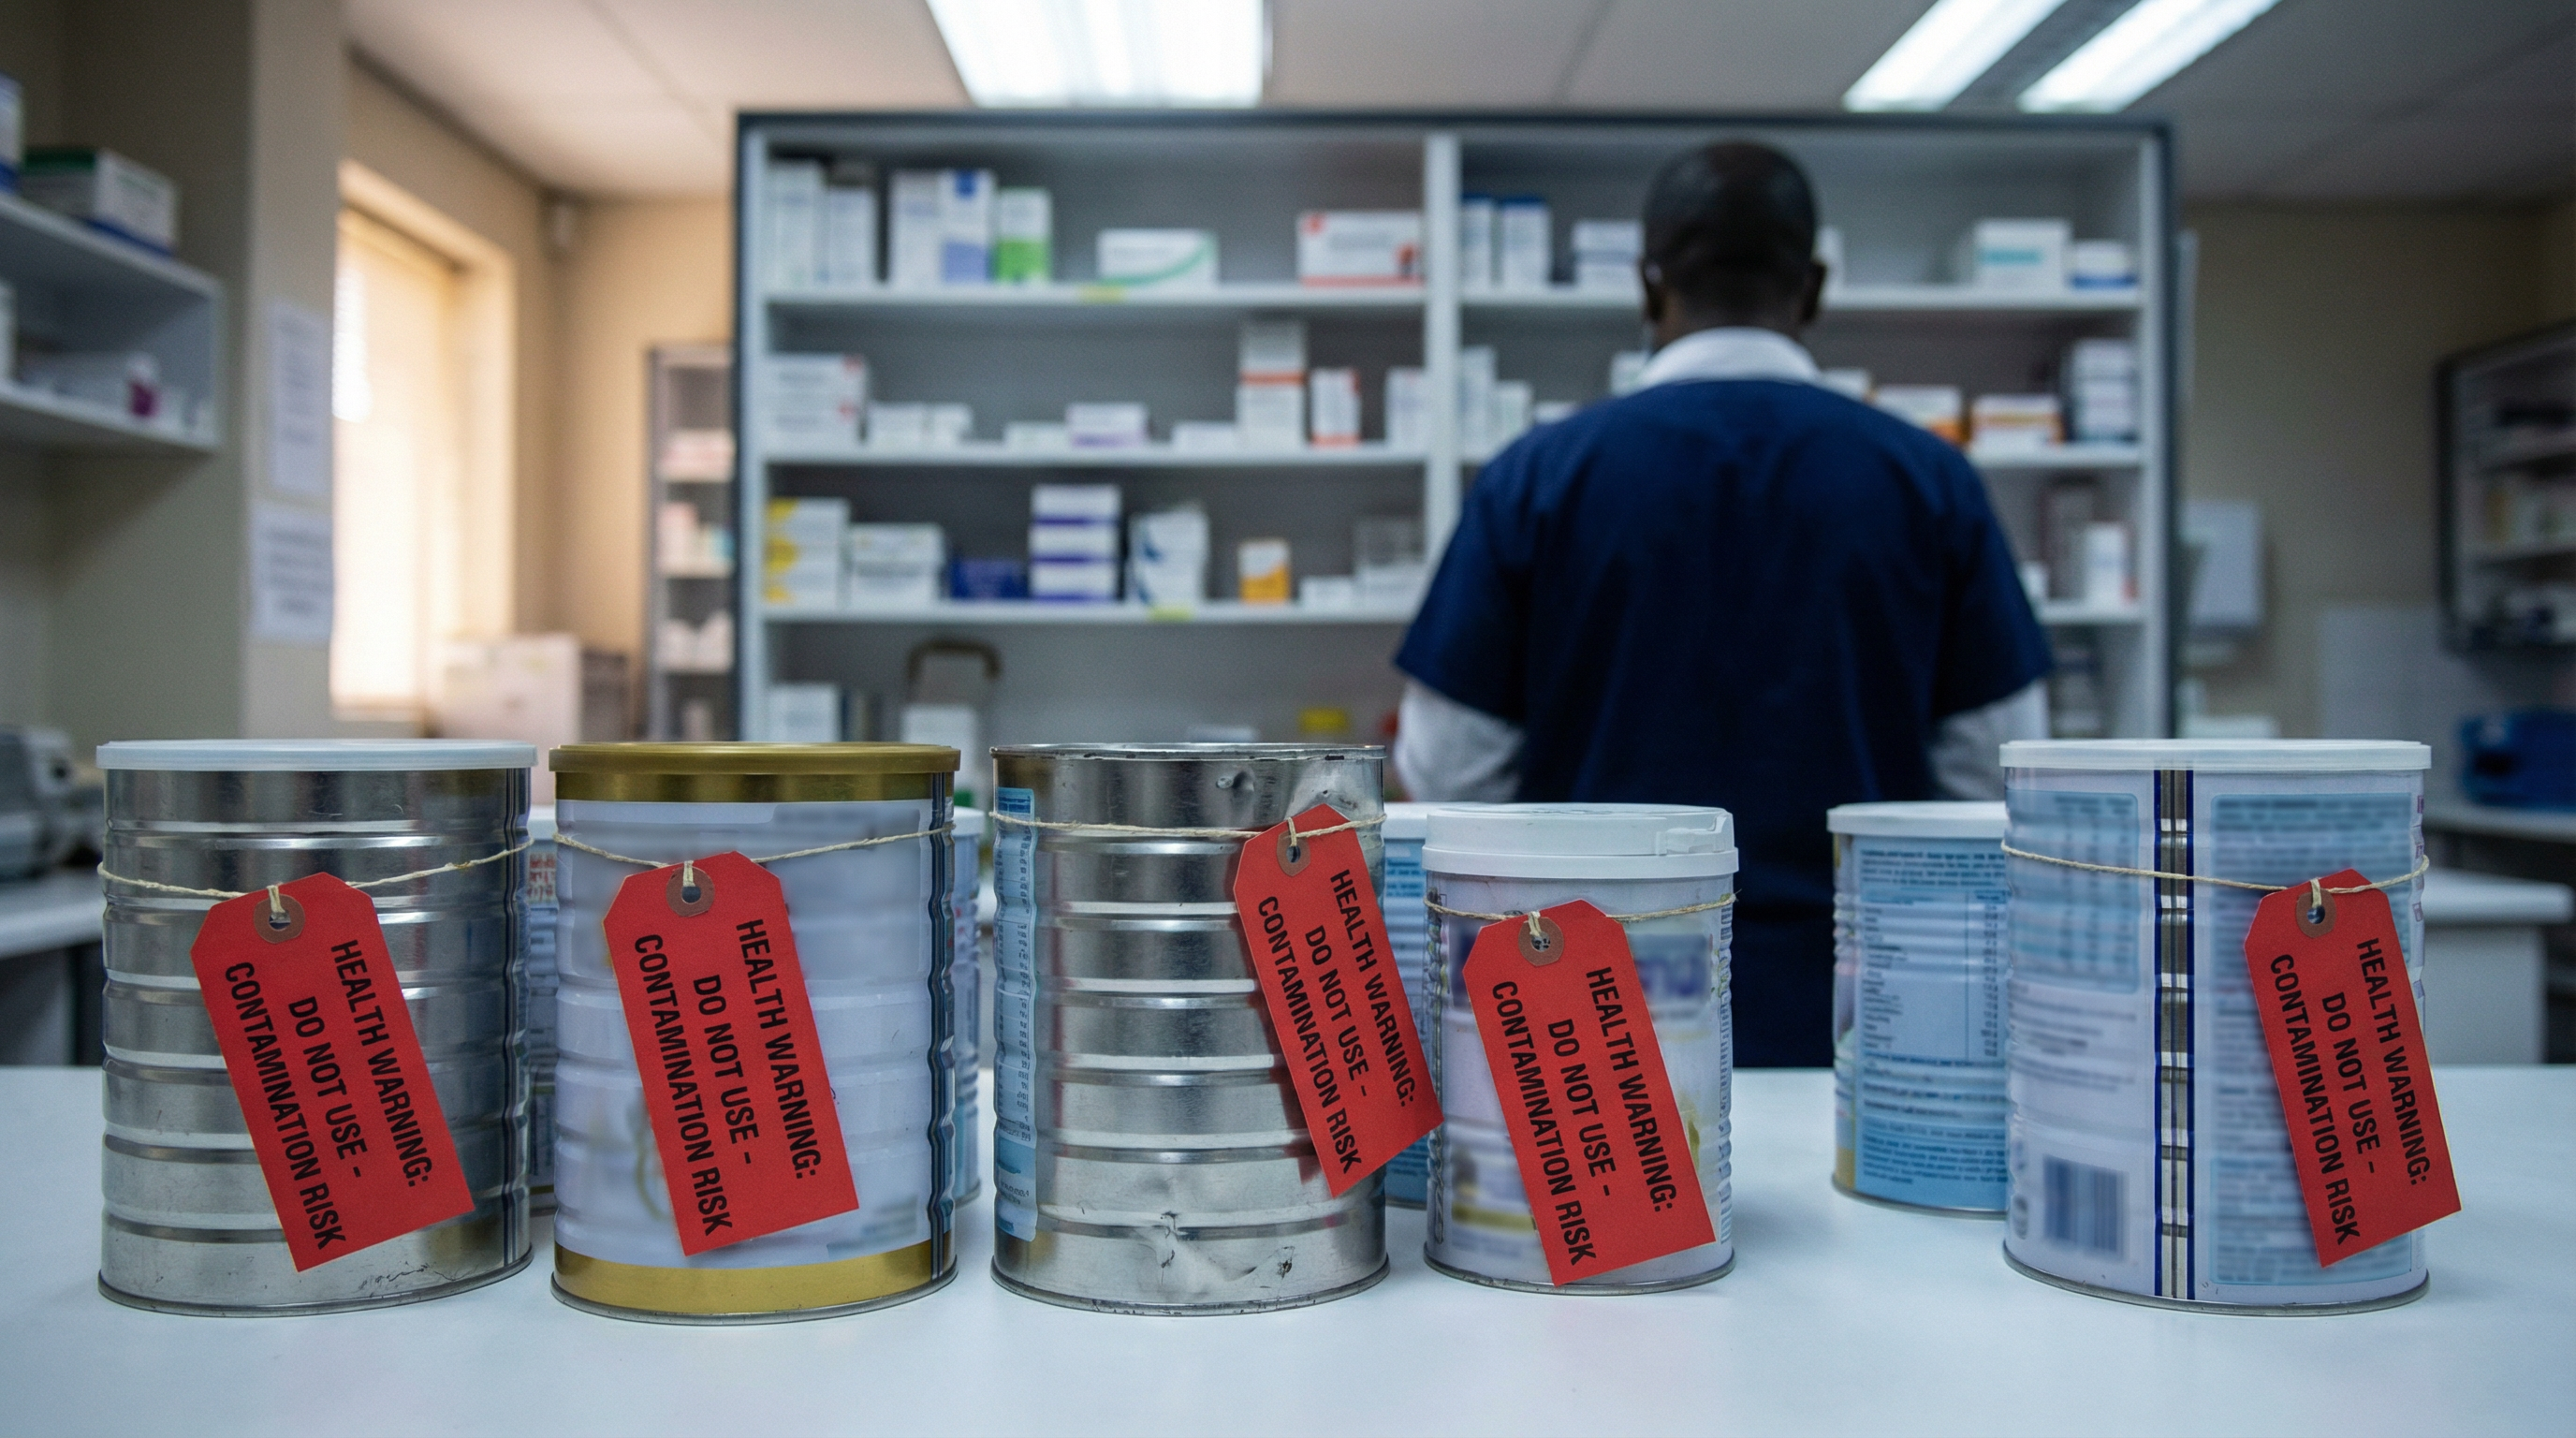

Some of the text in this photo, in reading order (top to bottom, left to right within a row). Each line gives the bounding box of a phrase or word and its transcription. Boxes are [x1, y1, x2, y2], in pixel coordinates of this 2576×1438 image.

[1305, 924, 1333, 966] DO
[287, 995, 326, 1038] DO
[692, 974, 727, 1016] DO
[1318, 967, 1353, 1022] NOT
[1329, 869, 1416, 1108] HEALTH WARNING:
[2320, 990, 2352, 1033] DO
[330, 939, 433, 1188] HEALTH WARNING:
[703, 1022, 744, 1078] NOT
[735, 918, 822, 1180] HEALTH WARNING:
[1257, 896, 1362, 1175] CONTAMINATION RISK
[1338, 1024, 1369, 1081] USE
[1547, 1018, 1581, 1058] DO
[2356, 937, 2432, 1186] HEALTH WARNING:
[302, 1041, 348, 1098] NOT
[634, 933, 733, 1237] CONTAMINATION RISK
[1559, 1063, 1600, 1116] NOT
[1585, 966, 1640, 1072] HEALTH
[1617, 1072, 1677, 1212] WARNING:
[2332, 1036, 2368, 1093] NOT
[224, 961, 347, 1251] CONTAMINATION RISK
[720, 1085, 760, 1145] USE
[1491, 980, 1597, 1267] CONTAMINATION RISK
[2269, 953, 2362, 1247] CONTAMINATION RISK
[2347, 1098, 2381, 1155] USE
[324, 1102, 369, 1161] USE
[1578, 1123, 1617, 1178] USE
